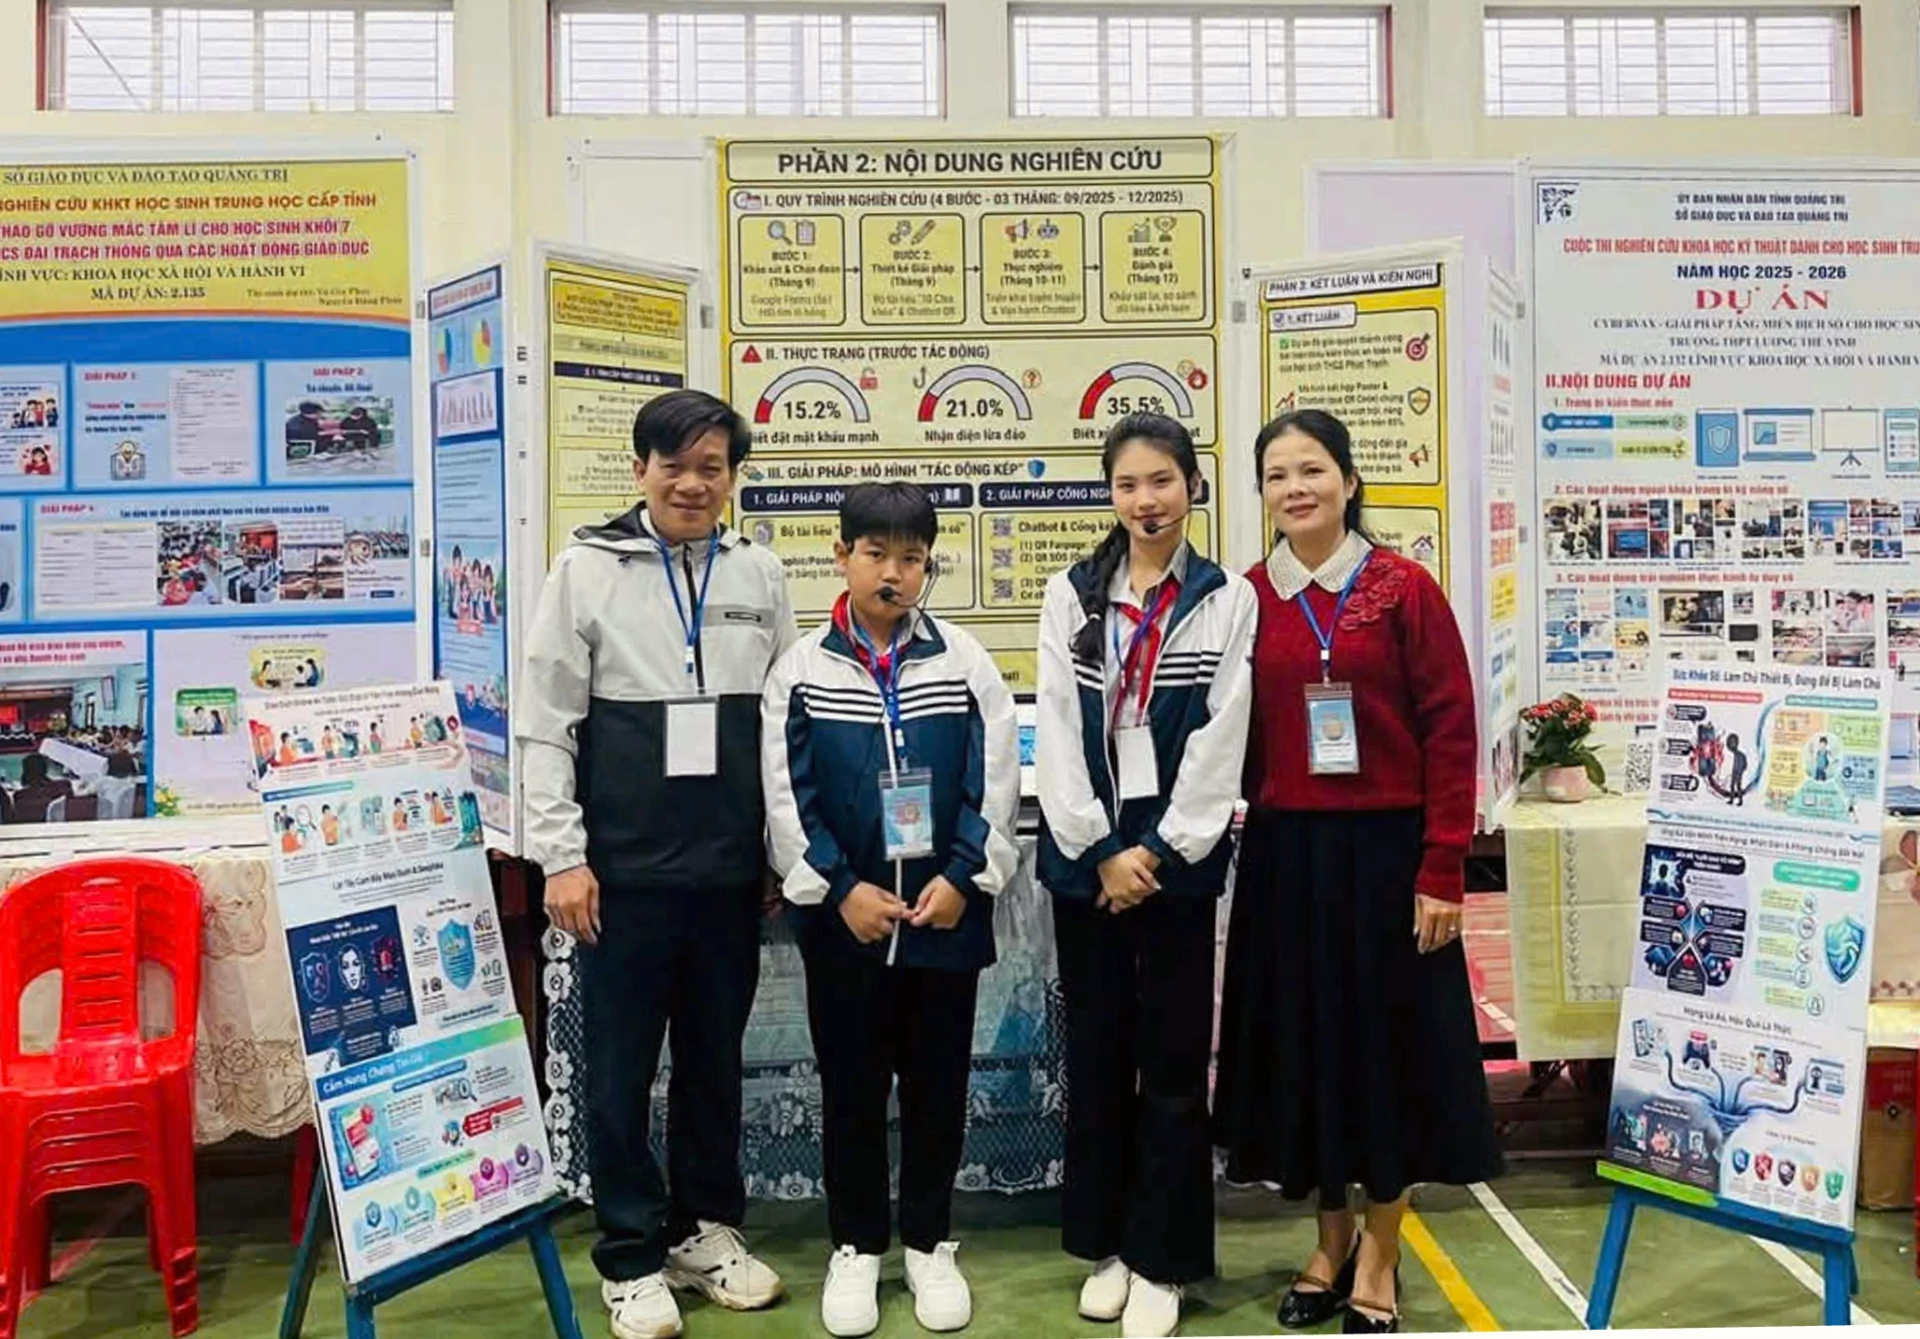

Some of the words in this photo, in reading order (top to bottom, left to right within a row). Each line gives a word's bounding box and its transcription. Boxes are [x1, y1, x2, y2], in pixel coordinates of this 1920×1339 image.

[779, 147, 848, 173] PHẦN
[855, 153, 877, 173] 2:
[885, 149, 927, 177] NỘI
[935, 152, 1003, 173] DUNG
[1011, 147, 1103, 172] NGHIÊN
[1110, 146, 1162, 171] CỨU
[55, 196, 87, 211] CỨU
[93, 198, 130, 211] KHKT
[135, 197, 170, 213] HỌC
[175, 197, 209, 210] SINH
[215, 196, 264, 209] TRUNG
[268, 195, 303, 210] HỌC
[308, 190, 340, 207] CẤP
[344, 190, 377, 206] TỈNH
[763, 195, 773, 207] I.
[776, 194, 802, 208] QUY
[806, 192, 845, 207] TRÌNH
[849, 192, 896, 207] NGHIÊN
[899, 191, 928, 207] CỨU
[930, 193, 943, 208] (4
[946, 191, 981, 207] BƯỚC
[993, 193, 1009, 206] 03
[1013, 190, 1060, 205] THÁNG:
[1064, 191, 1116, 205] 09/2025
[1128, 190, 1183, 205] 12/2025)
[342, 220, 351, 232] 7
[1676, 262, 1714, 279] NĂM
[1719, 265, 1750, 281] HỌC
[1754, 265, 1793, 279] 2025
[1808, 265, 1847, 279] 2026
[1696, 286, 1761, 315] DỰ
[1771, 283, 1829, 310] ÁN
[766, 347, 779, 360] II.
[783, 346, 818, 363] THỰC
[822, 346, 865, 362] TRẠNG
[868, 344, 917, 360] (TRƯỚC
[921, 343, 946, 359] TÁC
[949, 344, 990, 360] ĐỘNG)
[1545, 371, 1589, 392] II.NỘI
[1594, 373, 1638, 389] DUNG
[1643, 373, 1666, 391] DỰ
[1669, 371, 1691, 389] ÁN
[783, 400, 842, 420] 15.2%
[946, 398, 1004, 418] 21.0%
[1107, 396, 1165, 416] 35.5%
[767, 466, 783, 479] III.
[788, 464, 814, 479] GIẢI
[818, 464, 858, 479] PHÁP:
[861, 464, 882, 478] MÔ
[885, 463, 917, 478] HÌNH
[954, 463, 991, 478] ĐỘNG
[753, 493, 765, 505] 1.
[986, 489, 997, 501] 2.
[1018, 521, 1058, 533] Chatbot
[1060, 522, 1067, 531] &
[1035, 541, 1047, 550] QR
[1035, 552, 1047, 562] QR
